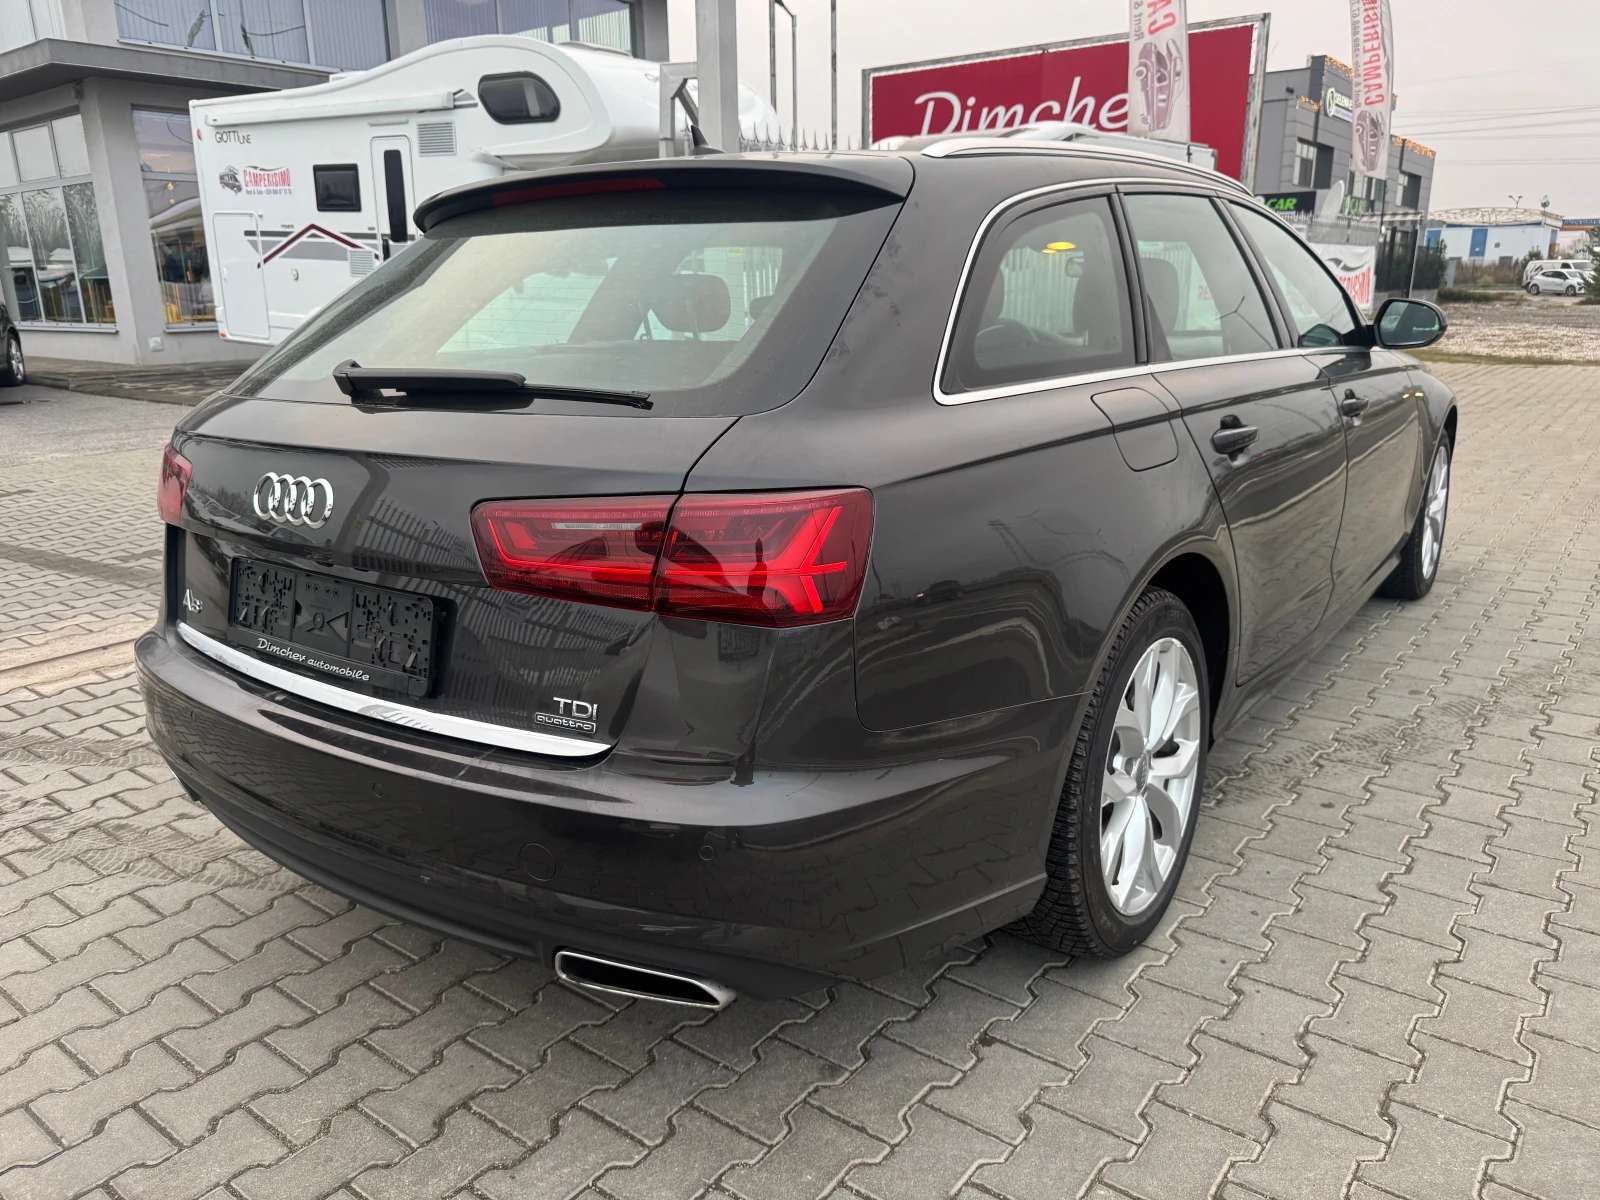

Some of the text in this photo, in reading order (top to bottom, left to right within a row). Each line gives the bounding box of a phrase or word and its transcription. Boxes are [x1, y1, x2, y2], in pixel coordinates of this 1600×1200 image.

[243, 168, 291, 188] CAMPERISIMO
[1266, 197, 1298, 211] CAR
[257, 637, 370, 681] Dimchev automobile
[553, 696, 598, 721] TDI
[537, 715, 592, 730] quattro
